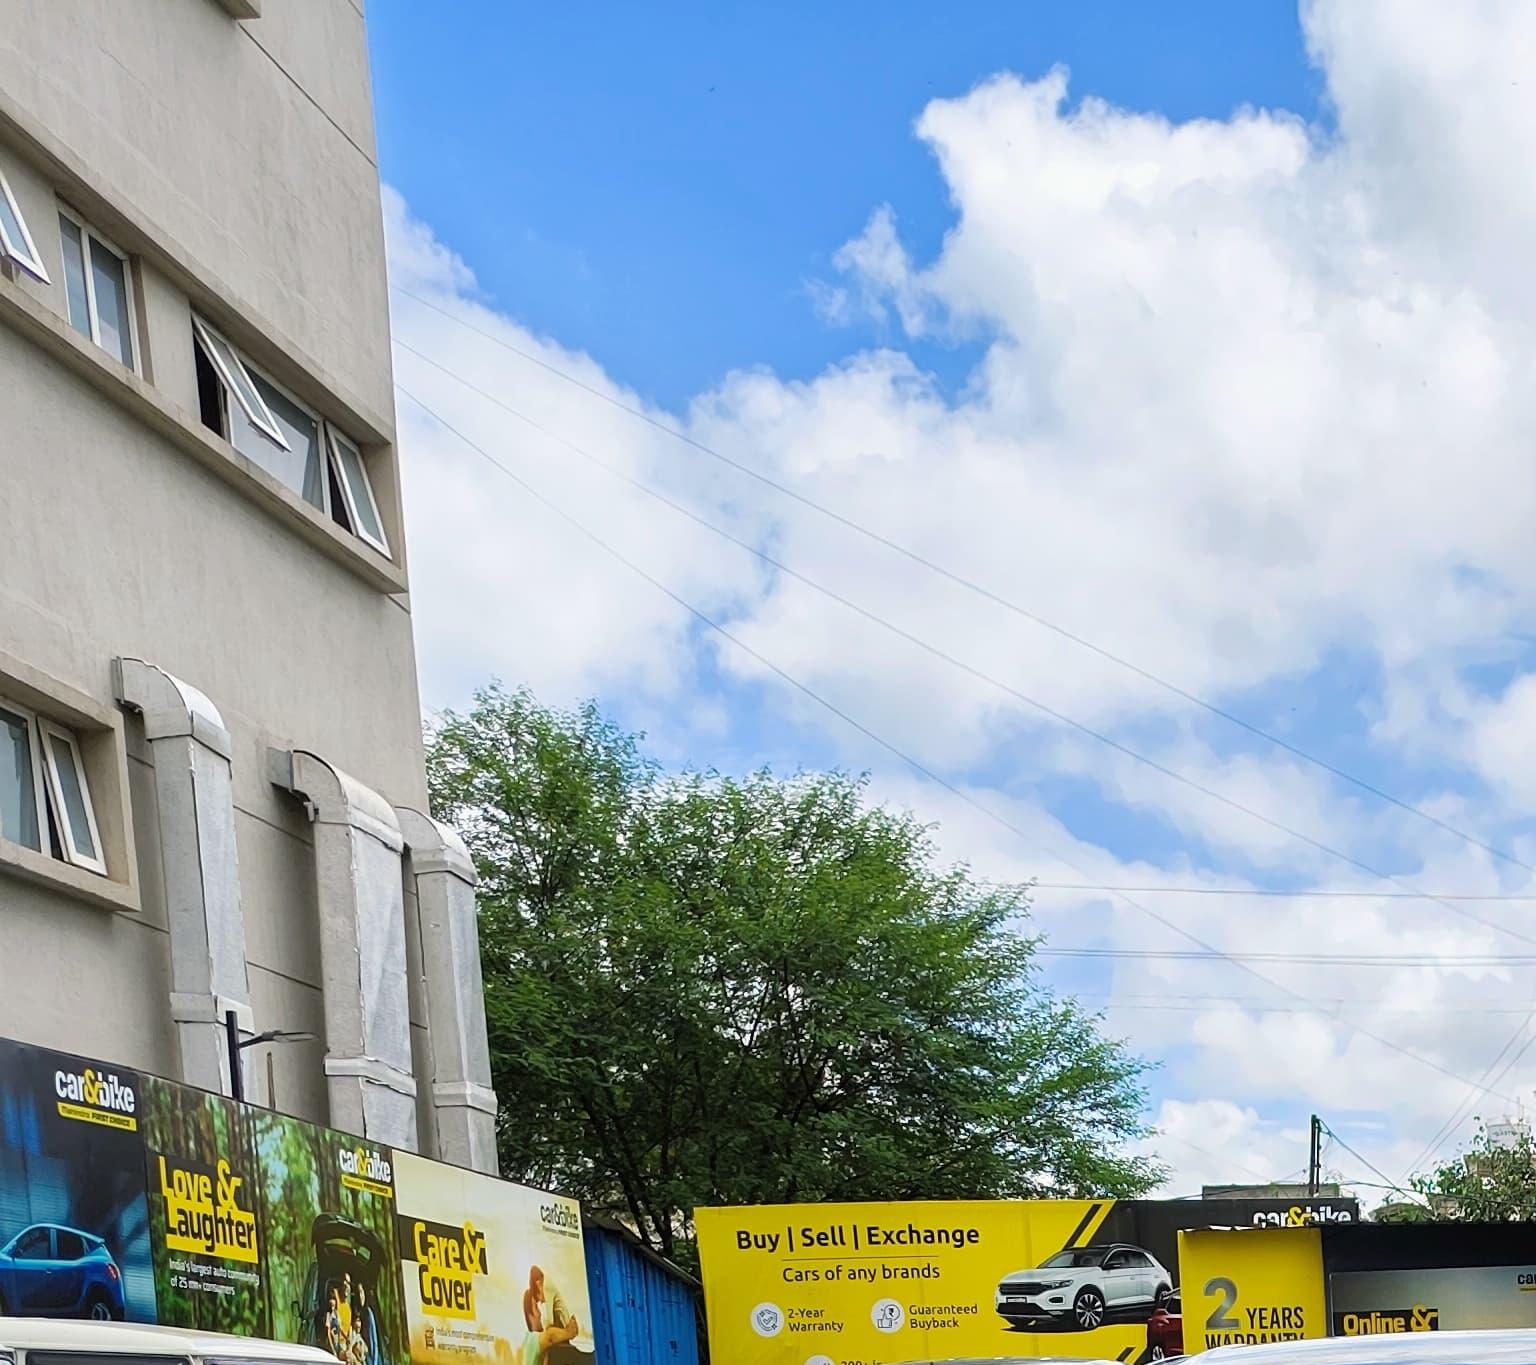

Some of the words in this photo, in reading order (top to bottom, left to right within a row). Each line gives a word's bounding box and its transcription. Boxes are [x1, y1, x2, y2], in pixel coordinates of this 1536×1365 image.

[55, 1068, 135, 1113] car&bike
[340, 1148, 391, 1183] car&bike
[159, 1155, 212, 1203] Love
[217, 1158, 242, 1211] &
[165, 1198, 255, 1252] Laughter
[736, 1230, 780, 1252] Buy
[801, 1225, 846, 1247] Sell
[867, 1223, 980, 1249] Exchange
[414, 1221, 461, 1269] Care
[463, 1220, 487, 1273] &
[418, 1264, 472, 1312] Cover
[782, 1267, 820, 1282] Cars
[824, 1265, 843, 1281] of
[847, 1267, 877, 1283] any
[882, 1264, 941, 1279] brands
[787, 1308, 825, 1319] 2-Year
[909, 1304, 978, 1316] Guaranteed
[1203, 1276, 1240, 1331] 2
[1246, 1306, 1305, 1330] YEARS
[788, 1320, 844, 1333] Warranty
[909, 1318, 960, 1330] Buyback
[1343, 1311, 1406, 1336] Online
